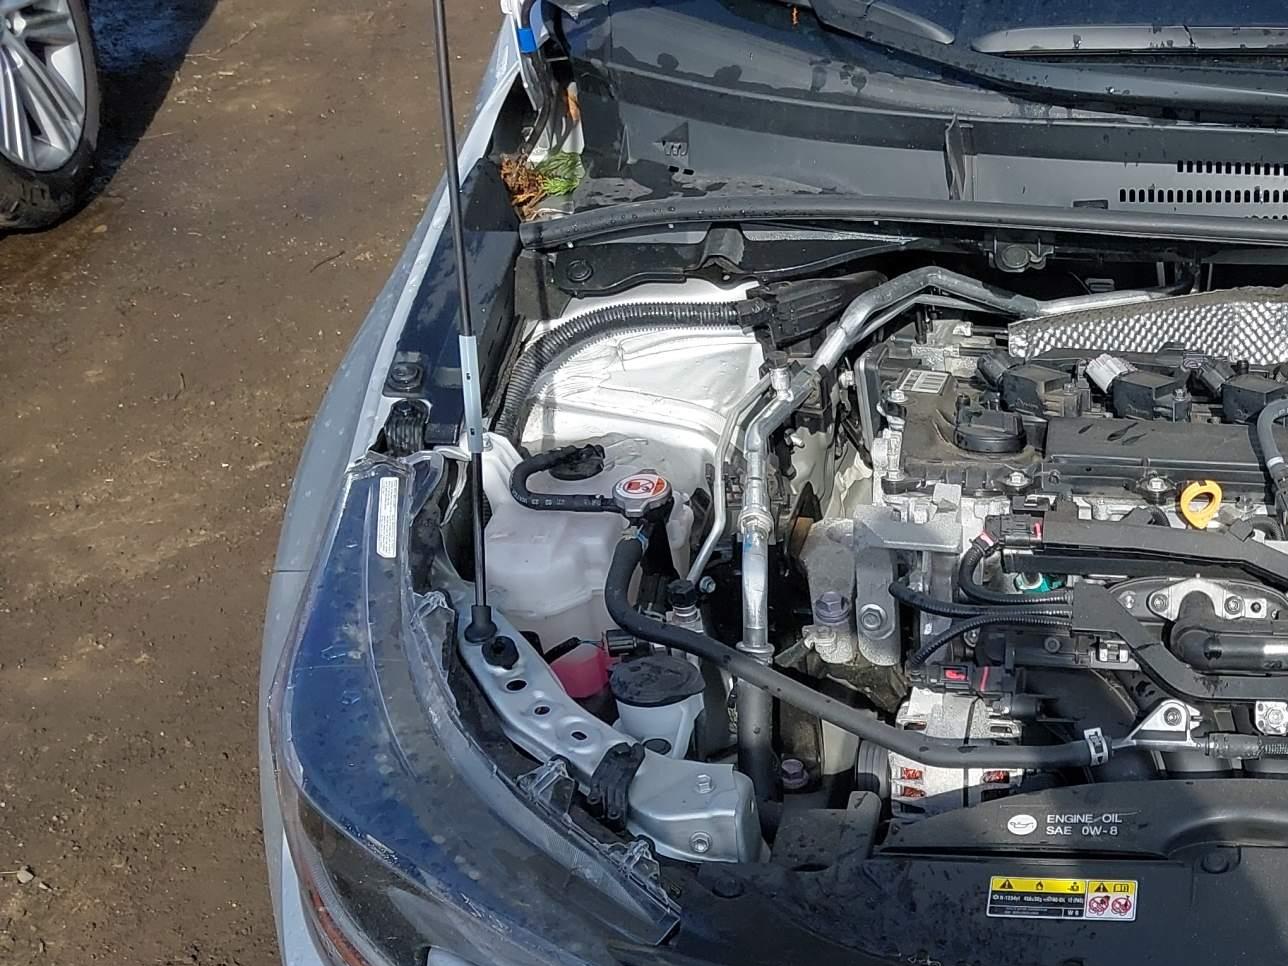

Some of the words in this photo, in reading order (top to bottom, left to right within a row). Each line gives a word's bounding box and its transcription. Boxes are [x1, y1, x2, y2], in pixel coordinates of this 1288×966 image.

[1046, 814, 1093, 824] ENGINE
[1102, 813, 1122, 823] OIL
[1046, 826, 1073, 836] SAE
[1082, 826, 1118, 836] 0W-8
